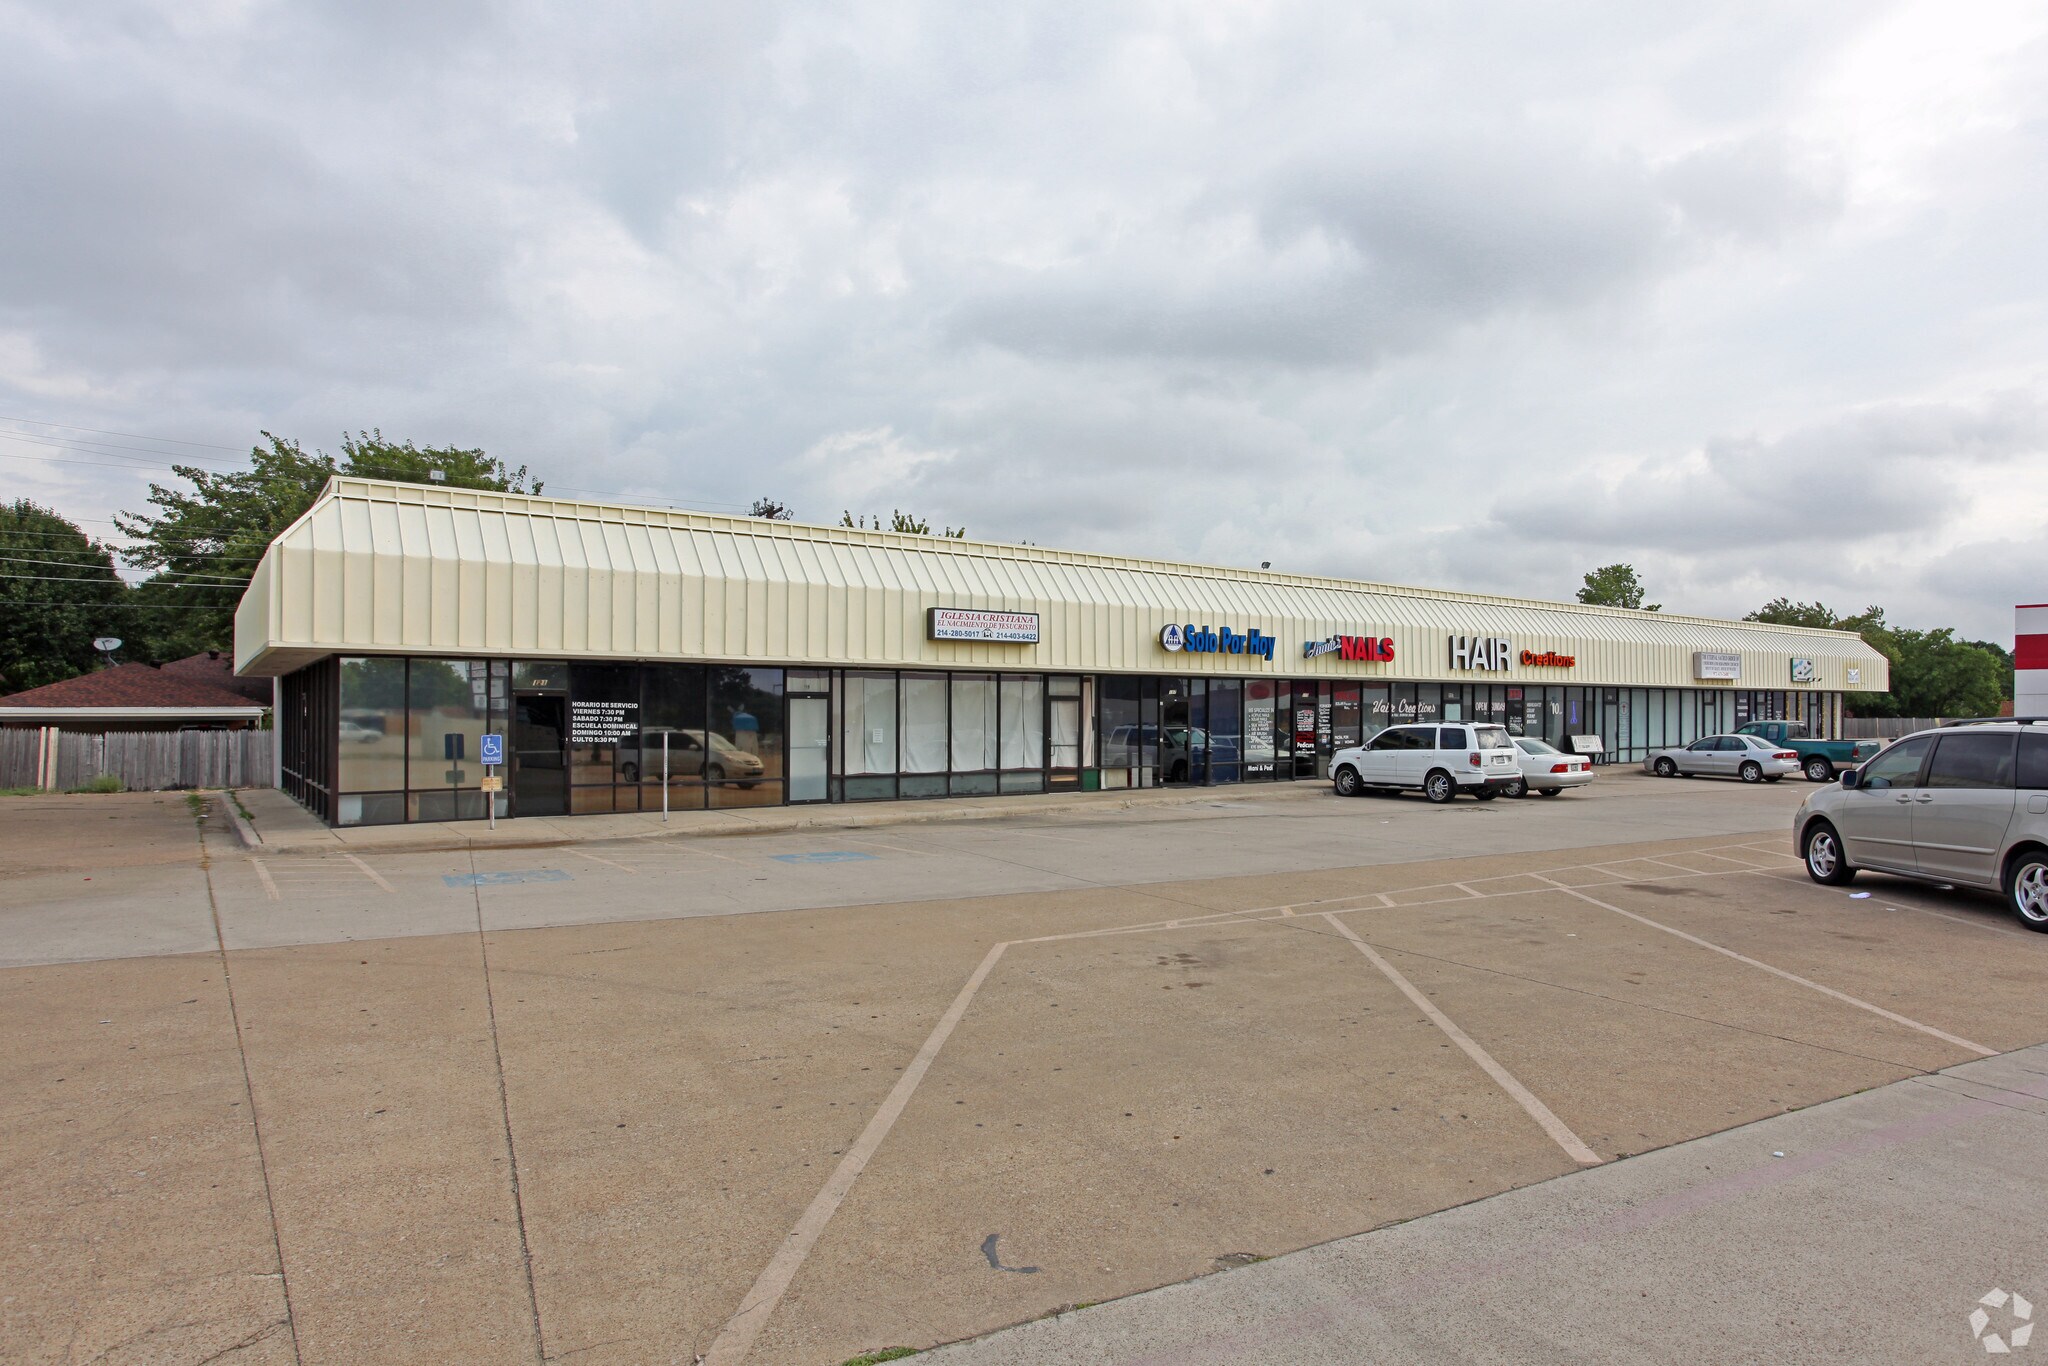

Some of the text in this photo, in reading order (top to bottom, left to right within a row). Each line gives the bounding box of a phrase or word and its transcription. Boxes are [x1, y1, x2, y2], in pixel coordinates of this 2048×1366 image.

[940, 611, 1033, 624] IGLESIA CRISTIANA
[946, 620, 988, 628] NACIMIENTO
[998, 623, 1036, 631] JESUCRISTO
[1183, 624, 1276, 661] Solo Por Hoy
[1338, 635, 1395, 662] NAILS
[1448, 635, 1512, 671] HAIR
[1520, 649, 1576, 668] Creations
[1398, 698, 1436, 713] Creations
[1475, 702, 1488, 711] OPEN
